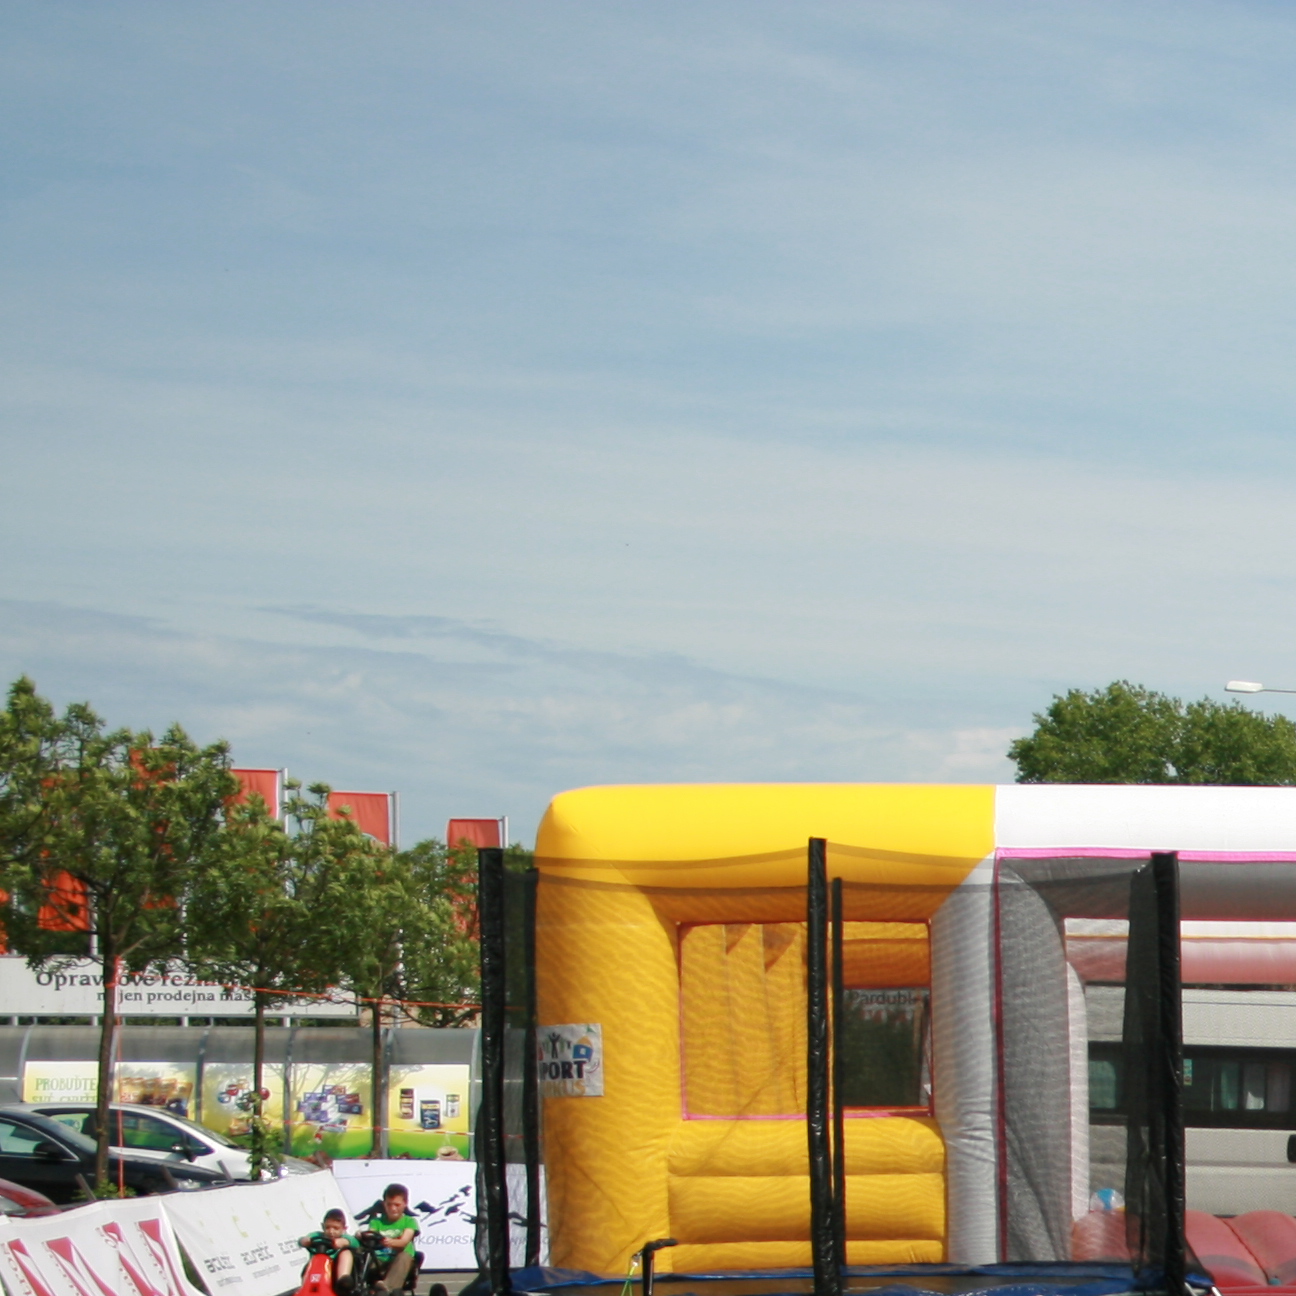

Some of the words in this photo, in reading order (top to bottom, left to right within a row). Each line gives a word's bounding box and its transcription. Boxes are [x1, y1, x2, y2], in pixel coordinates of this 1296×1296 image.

[146, 989, 215, 1005] prodejna
[220, 991, 252, 1002] mas
[538, 1060, 587, 1080] PORT
